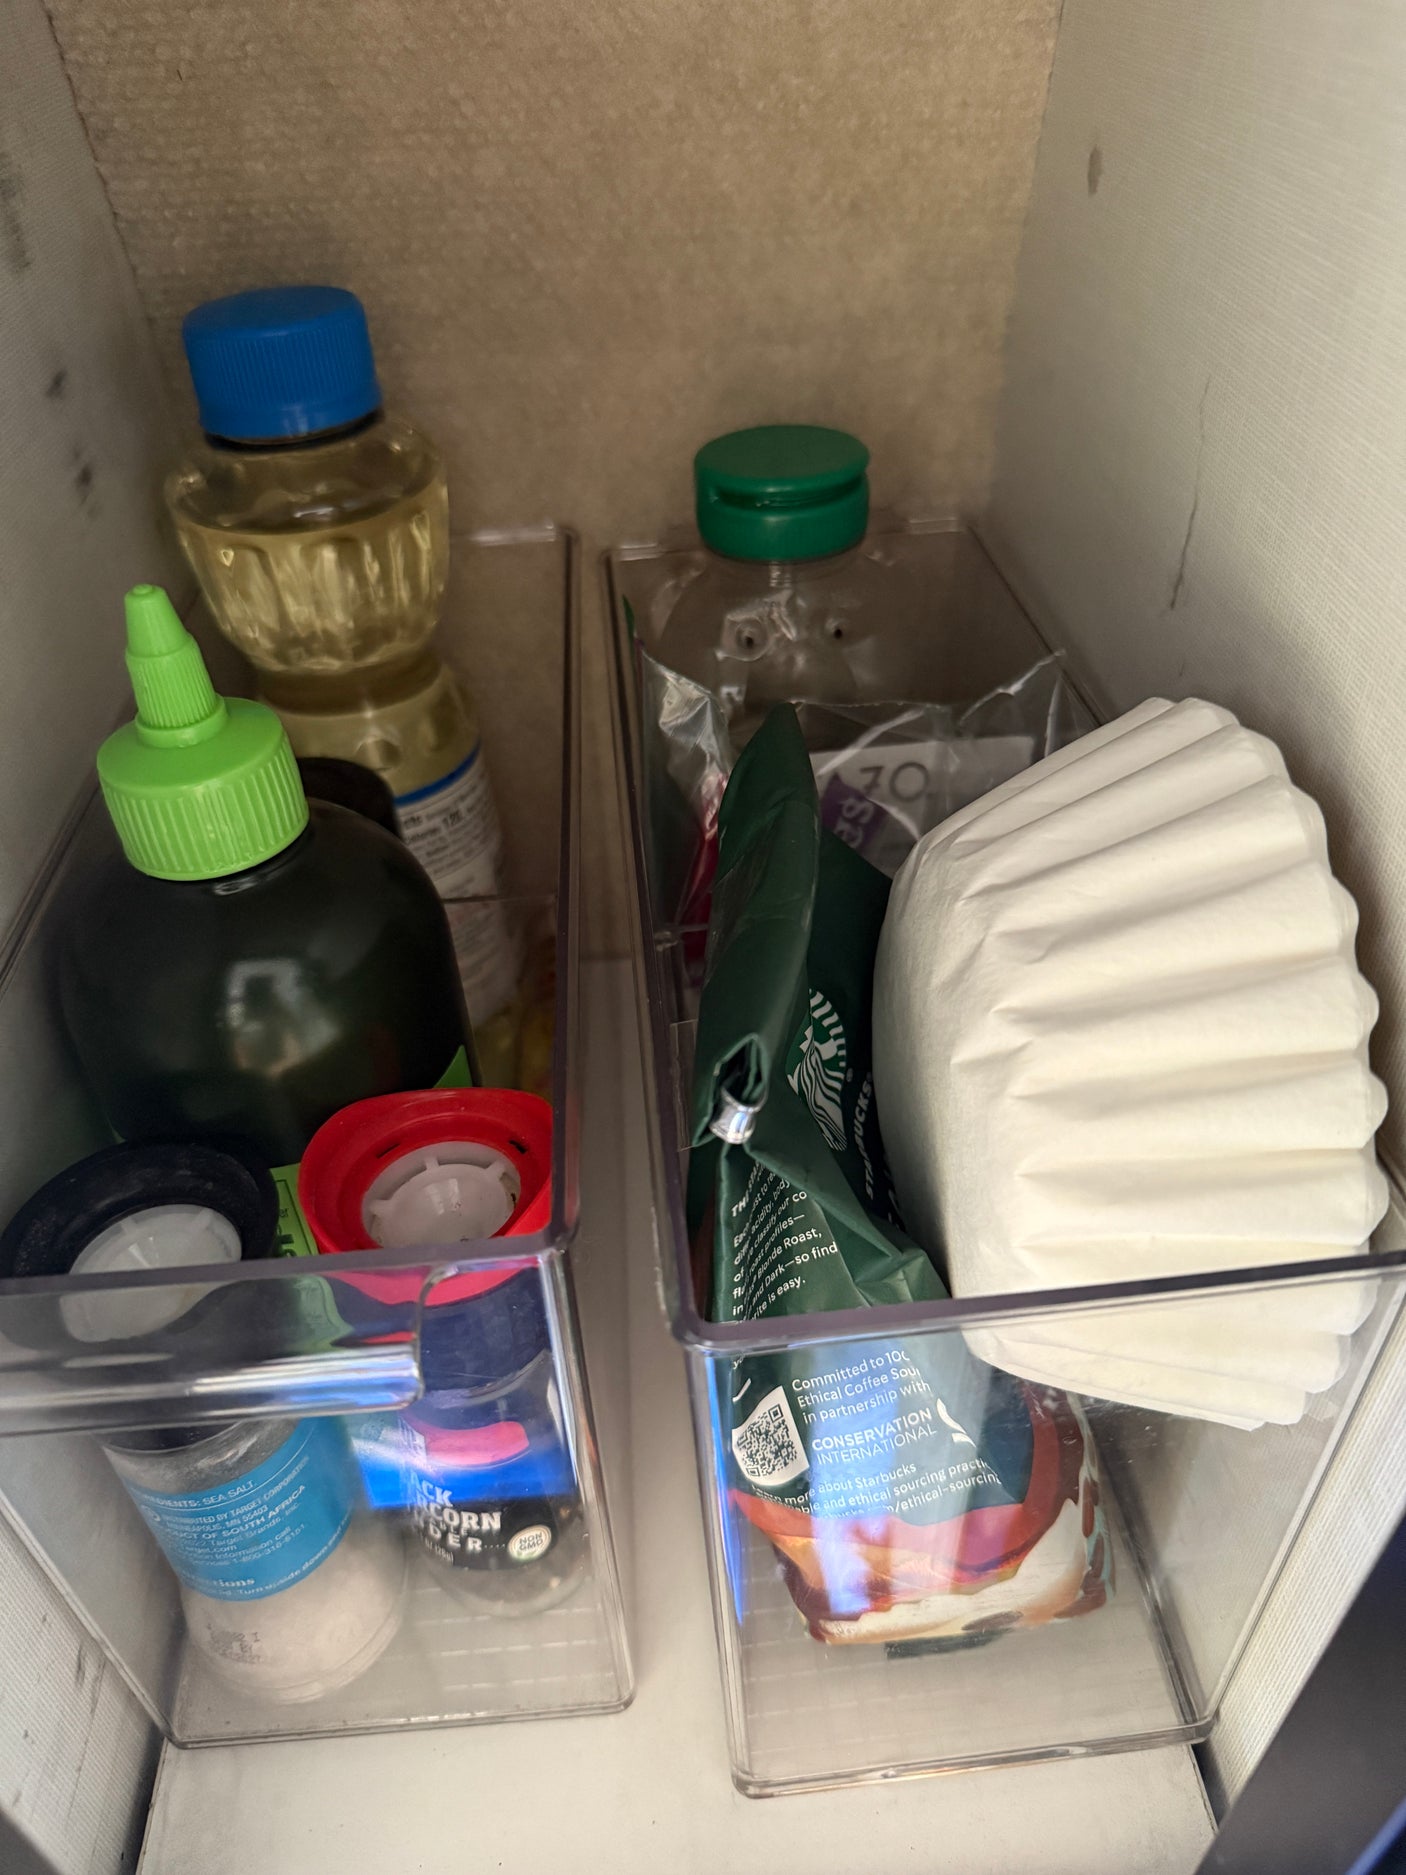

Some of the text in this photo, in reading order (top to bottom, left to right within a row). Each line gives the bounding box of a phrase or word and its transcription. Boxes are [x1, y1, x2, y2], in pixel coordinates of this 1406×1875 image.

[751, 1201, 775, 1235] acidity,
[754, 1213, 777, 1249] classify
[777, 1196, 790, 1216] our
[757, 1227, 823, 1280] Blonde Roast,
[767, 1291, 777, 1304] is
[776, 1275, 807, 1297] easy.
[791, 1358, 869, 1392] Committed
[869, 1356, 885, 1369] to
[797, 1388, 843, 1408] Ethical
[844, 1374, 889, 1397] Coffee
[802, 1379, 932, 1425] in partnership with
[811, 1407, 933, 1451] CONSERVATION
[816, 1424, 939, 1466] INTERNATIONAL
[202, 1494, 227, 1506] SEA
[784, 1488, 816, 1505] more
[818, 1478, 853, 1494] about
[854, 1462, 918, 1487] Starbucks
[823, 1495, 847, 1509] and
[847, 1487, 892, 1507] ethical
[893, 1471, 946, 1497] sourcing
[201, 1531, 219, 1540] OF
[222, 1516, 266, 1538] SOUTH
[267, 1484, 307, 1519] AFRICA
[230, 1500, 262, 1518] TARGET
